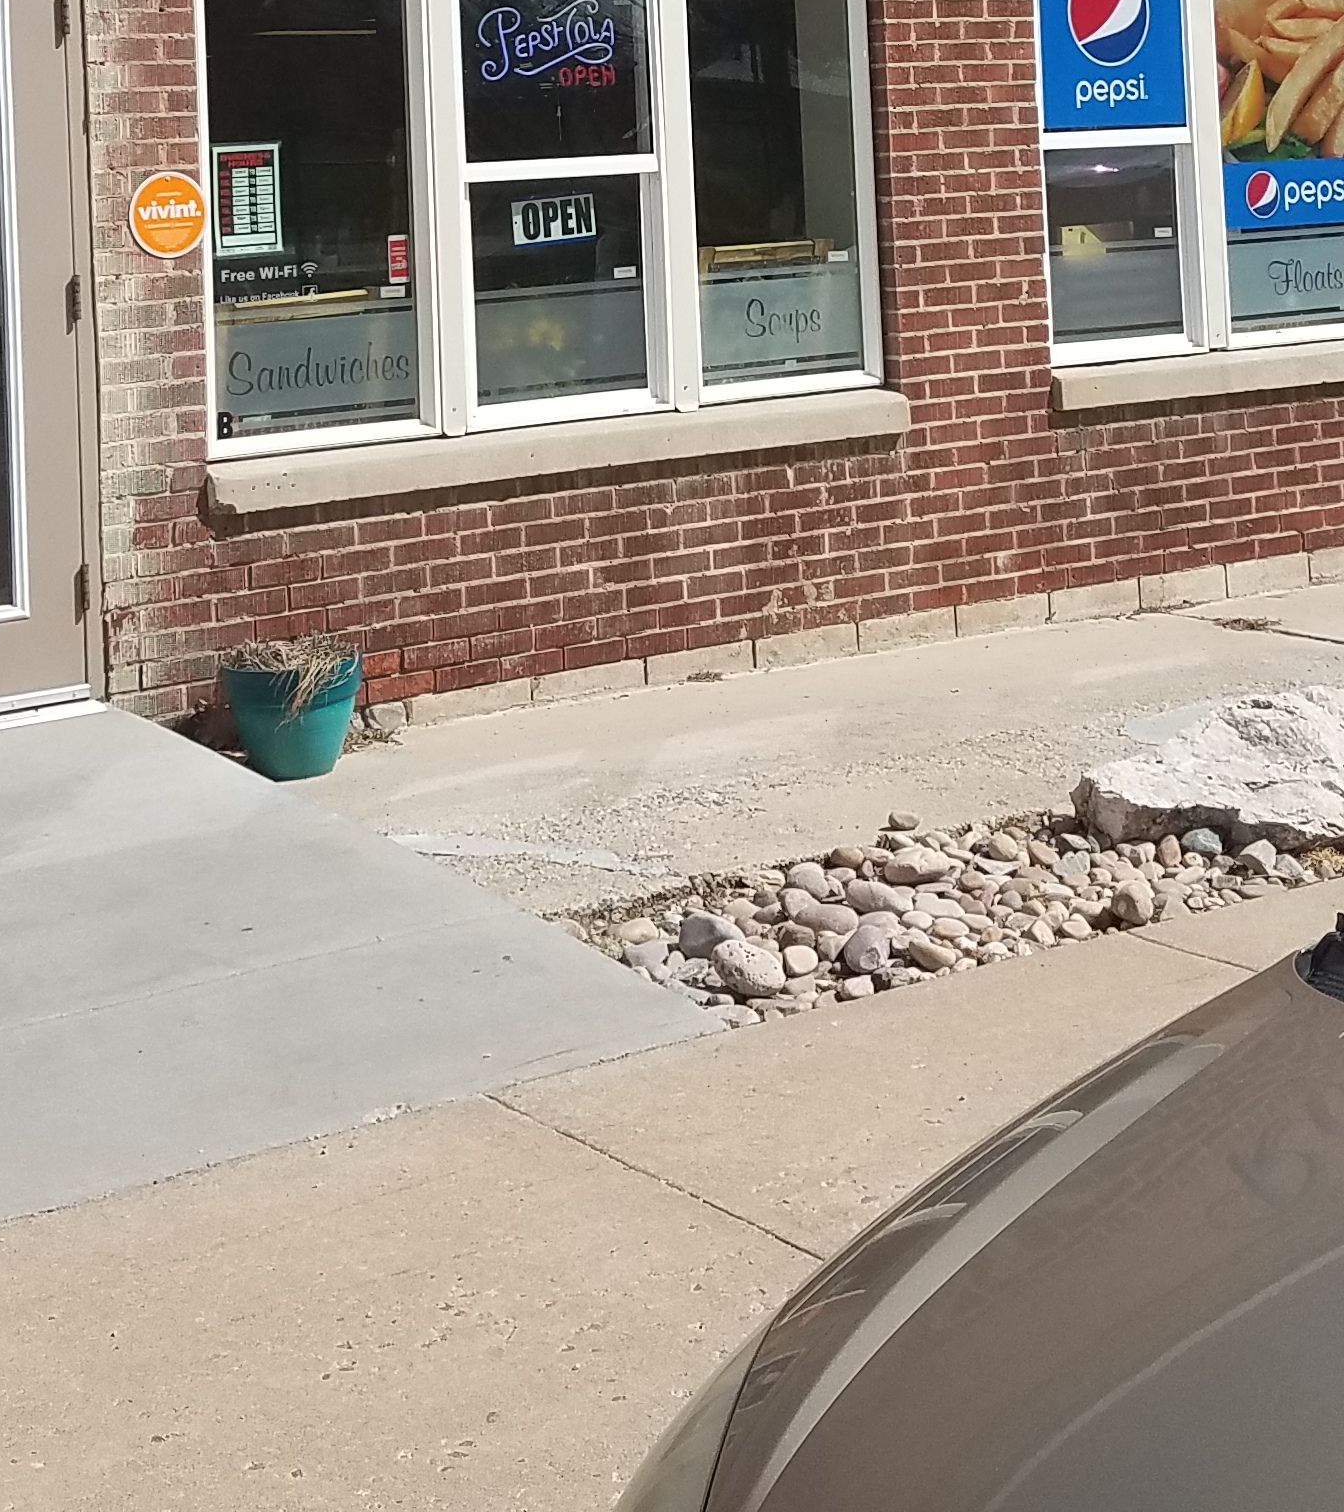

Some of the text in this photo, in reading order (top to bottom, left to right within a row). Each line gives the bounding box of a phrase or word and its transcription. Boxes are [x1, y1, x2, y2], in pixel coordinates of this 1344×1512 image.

[558, 63, 616, 87] OPEN
[1076, 73, 1148, 108] pepsi
[521, 196, 593, 240] OPEN
[221, 265, 298, 282] Free Wi-Fi
[1268, 258, 1343, 295] Floats
[220, 295, 237, 304] Like
[250, 294, 261, 302] on
[262, 290, 300, 301] Facebook
[745, 298, 821, 343] Soups
[227, 341, 410, 396] Sandwiches
